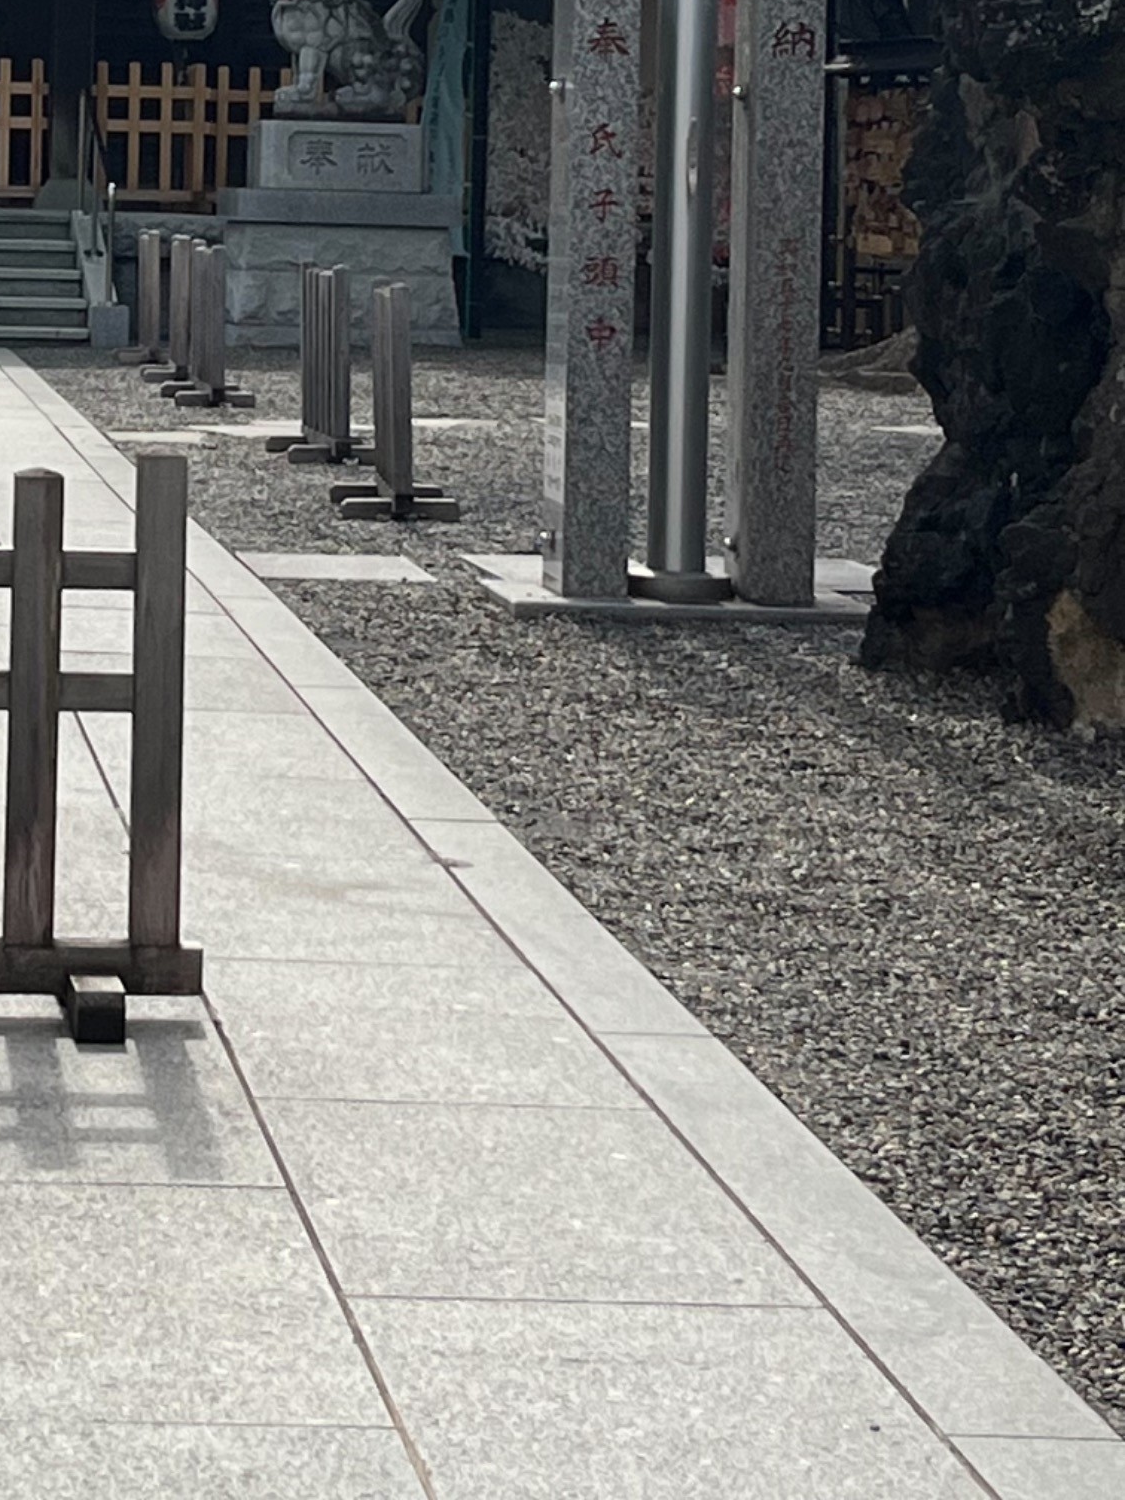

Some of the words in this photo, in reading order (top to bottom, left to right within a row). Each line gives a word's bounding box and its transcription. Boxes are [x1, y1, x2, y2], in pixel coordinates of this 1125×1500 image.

[587, 17, 630, 63] 奉
[772, 21, 816, 60] 納
[299, 139, 395, 176] 奉献
[580, 123, 623, 352] 氏子頭中
